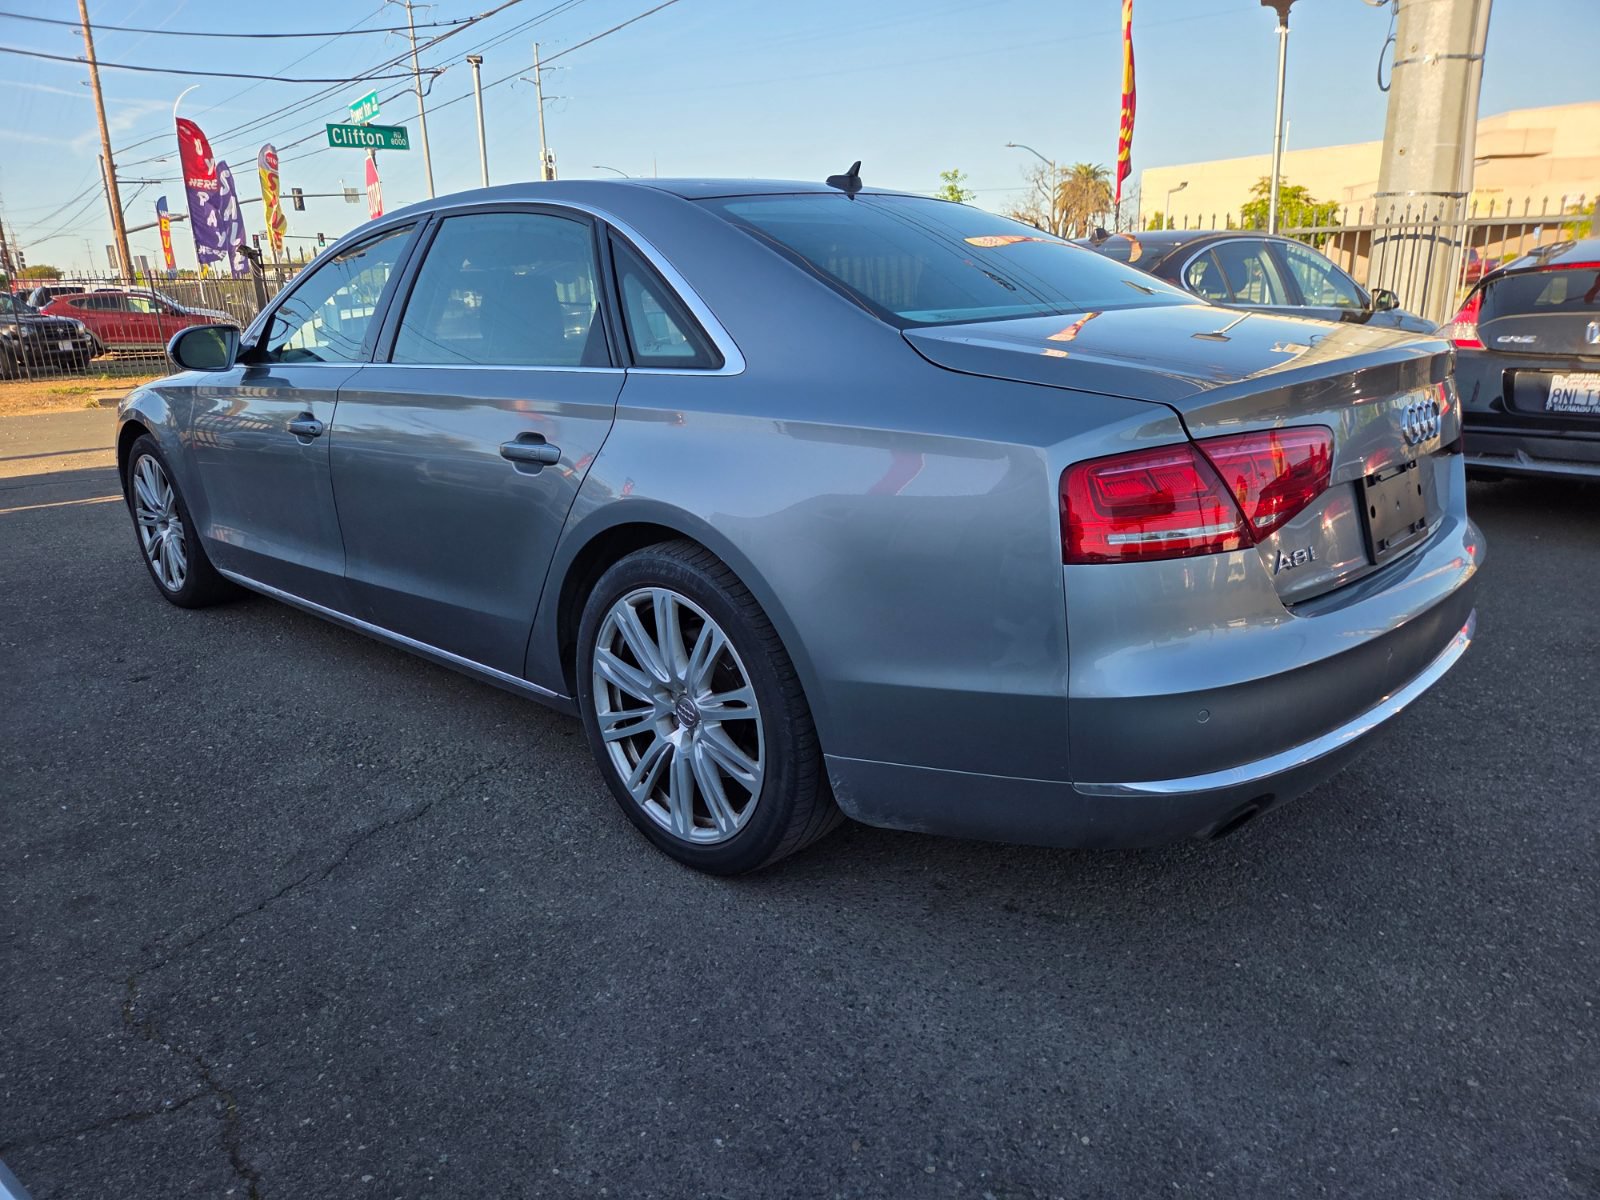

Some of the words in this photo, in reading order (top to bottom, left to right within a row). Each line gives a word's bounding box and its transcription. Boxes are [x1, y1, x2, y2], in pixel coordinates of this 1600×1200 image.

[332, 128, 385, 146] Clifton
[188, 177, 218, 191] HERE
[196, 191, 227, 248] PAY
[219, 169, 246, 272] SALE
[160, 219, 173, 266] BUY
[1274, 545, 1320, 575] A8L
